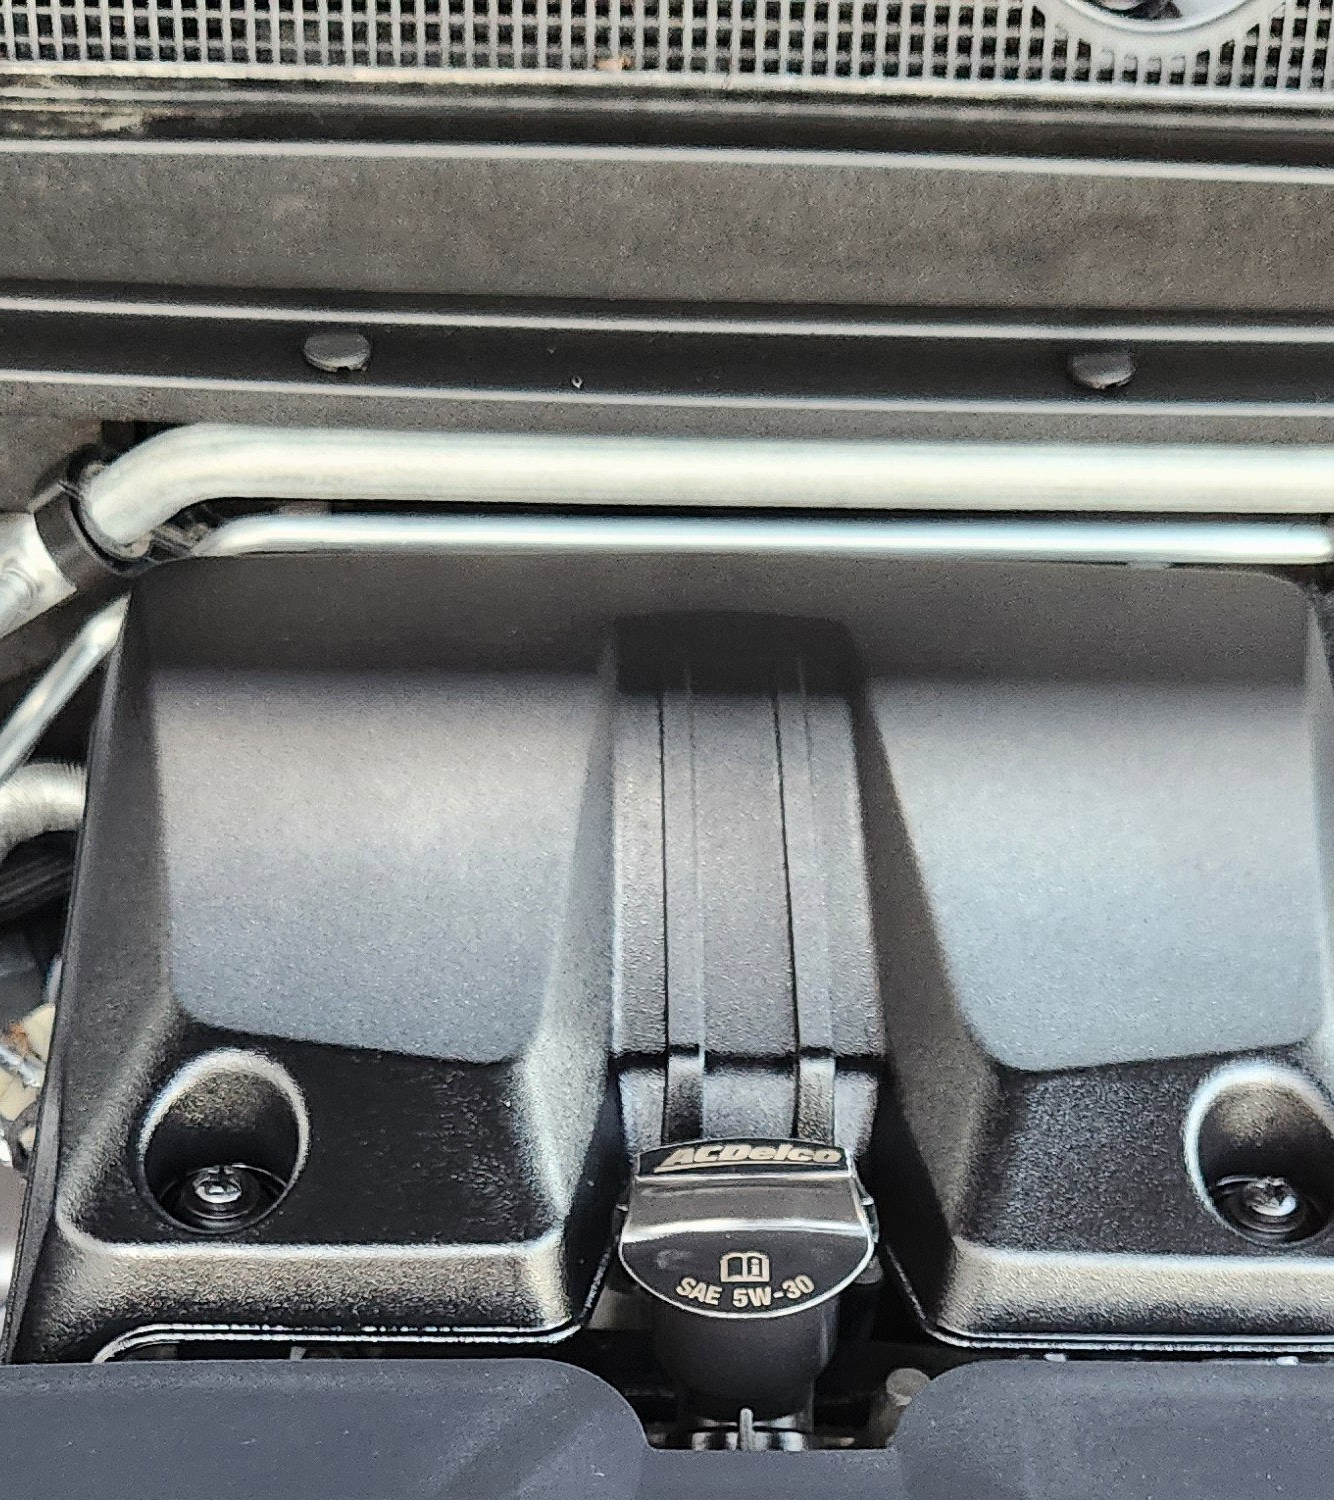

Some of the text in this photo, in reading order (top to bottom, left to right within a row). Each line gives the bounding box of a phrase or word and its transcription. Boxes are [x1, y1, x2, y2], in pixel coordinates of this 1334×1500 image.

[655, 1144, 842, 1171] ACDelco
[675, 1274, 816, 1309] SAE 5W-30
